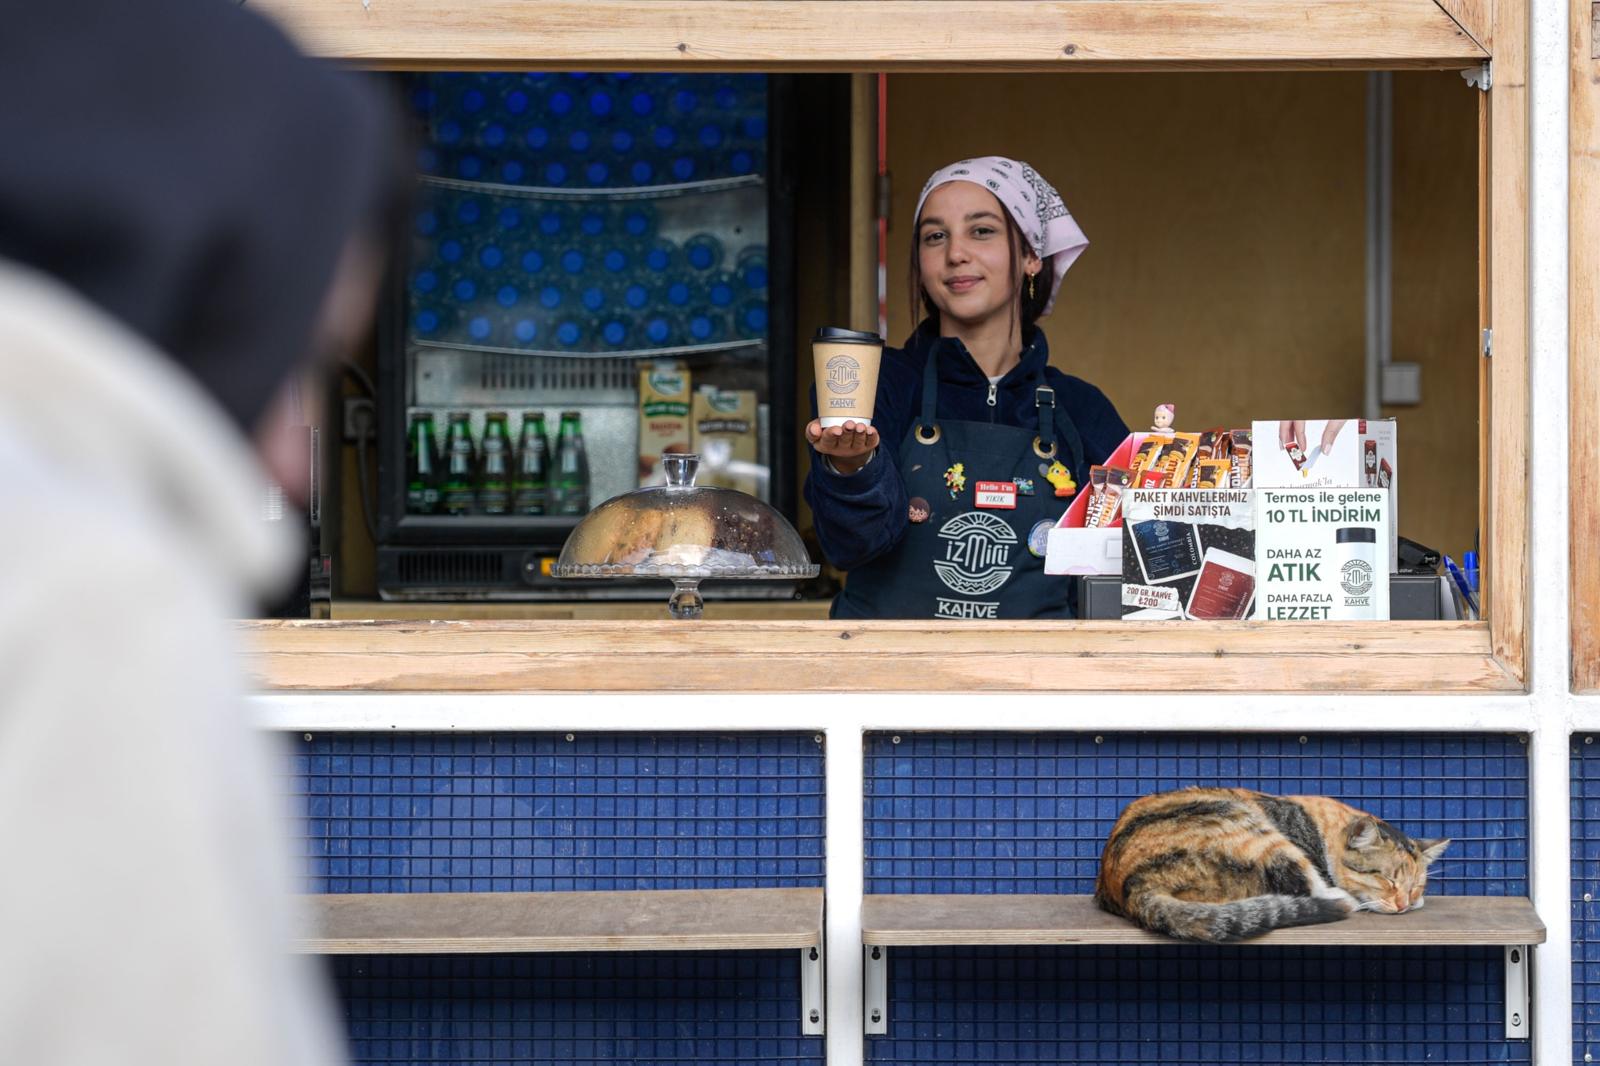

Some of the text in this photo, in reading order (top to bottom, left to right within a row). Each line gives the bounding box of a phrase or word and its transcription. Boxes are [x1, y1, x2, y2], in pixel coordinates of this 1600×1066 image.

[980, 483, 999, 491] Hello
[1133, 489, 1248, 503] PAKET KAHVELERİMİZ
[1264, 491, 1382, 505] Termos ile gelene
[1153, 504, 1232, 518] ŞİMDİ SATIŞTA
[1266, 506, 1381, 523] 10 TL İNDİRİM
[1266, 548, 1322, 559] DAHA AZ
[1267, 563, 1322, 582] ATIK
[1126, 587, 1139, 595] 200
[1151, 590, 1173, 601] KAHVE
[1267, 593, 1333, 603] DAHA FAZLA
[1344, 597, 1370, 606] KAHVE
[938, 600, 999, 619] KAHVE
[1267, 606, 1332, 620] LEZZET
